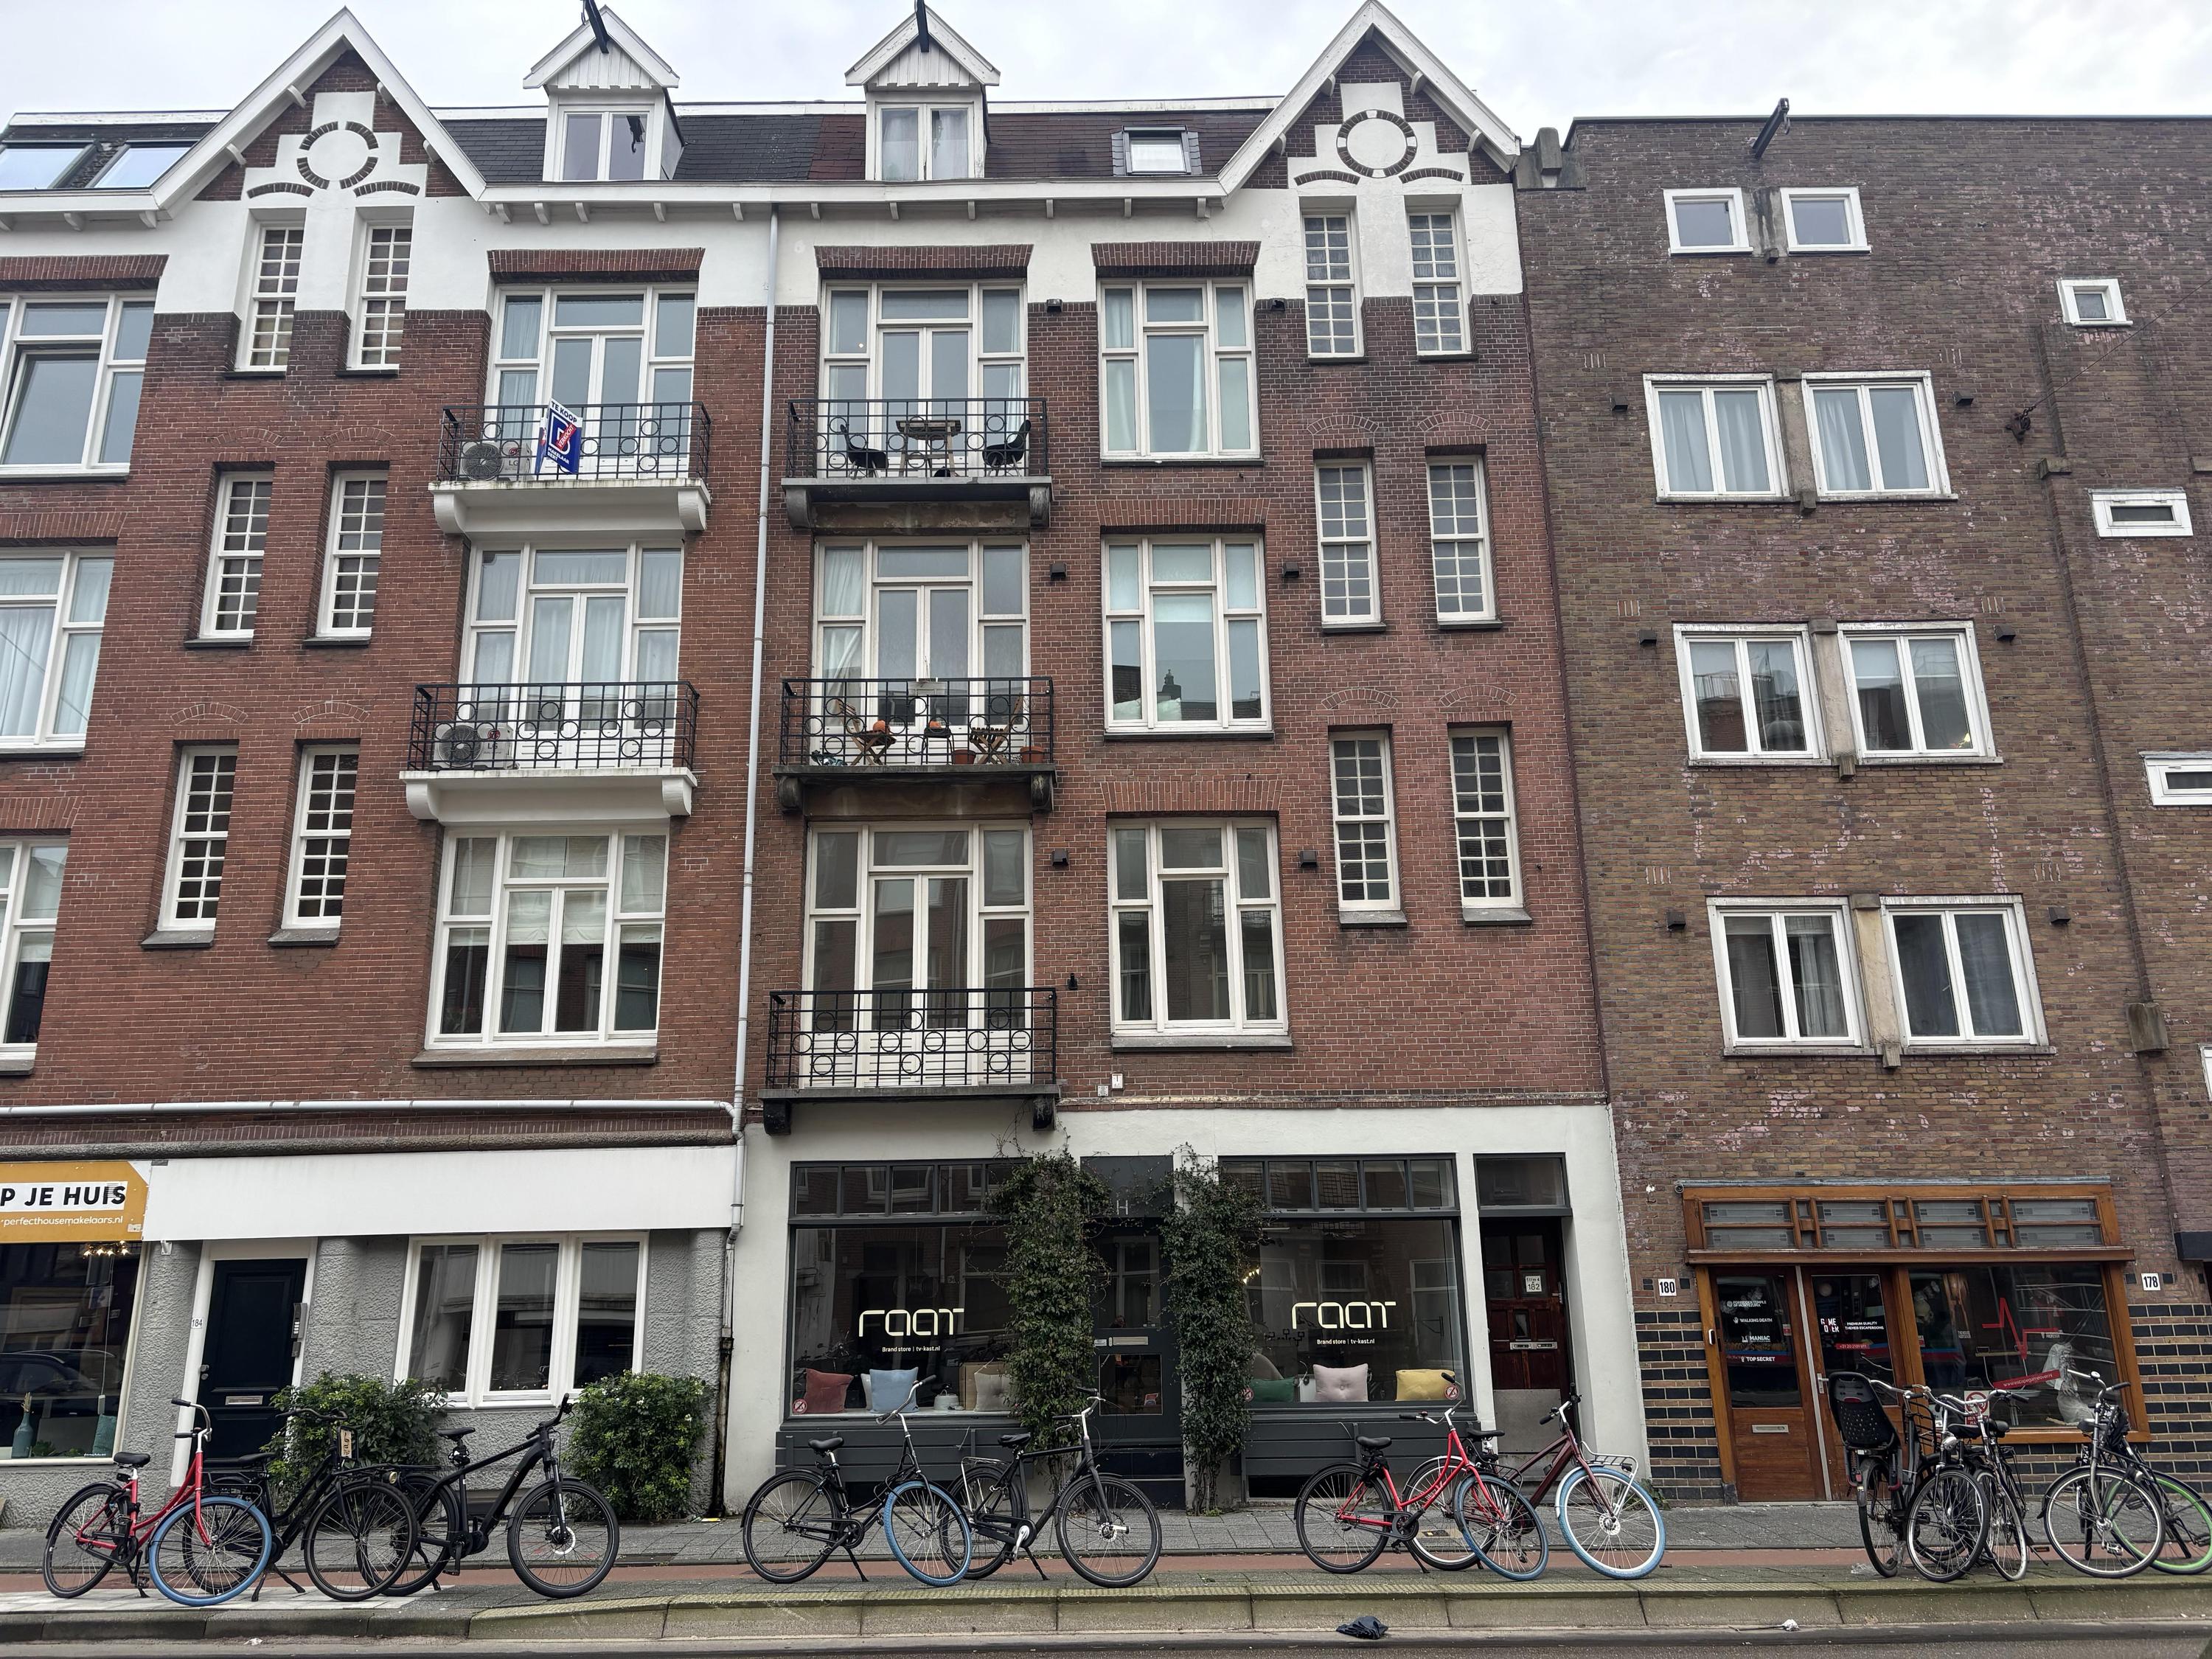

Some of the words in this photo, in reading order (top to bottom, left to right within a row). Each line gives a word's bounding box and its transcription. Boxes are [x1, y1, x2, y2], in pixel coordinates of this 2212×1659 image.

[551, 400, 559, 411] TE
[560, 407, 577, 423] KOOP
[557, 424, 574, 448] VERKOCHT
[547, 447, 569, 465] MAKELAAR
[24, 1187, 54, 1206] JE
[63, 1186, 125, 1206] HUIS
[1659, 1281, 1675, 1293] 180
[2143, 1276, 2158, 1288] 178
[192, 1318, 203, 1327] 184
